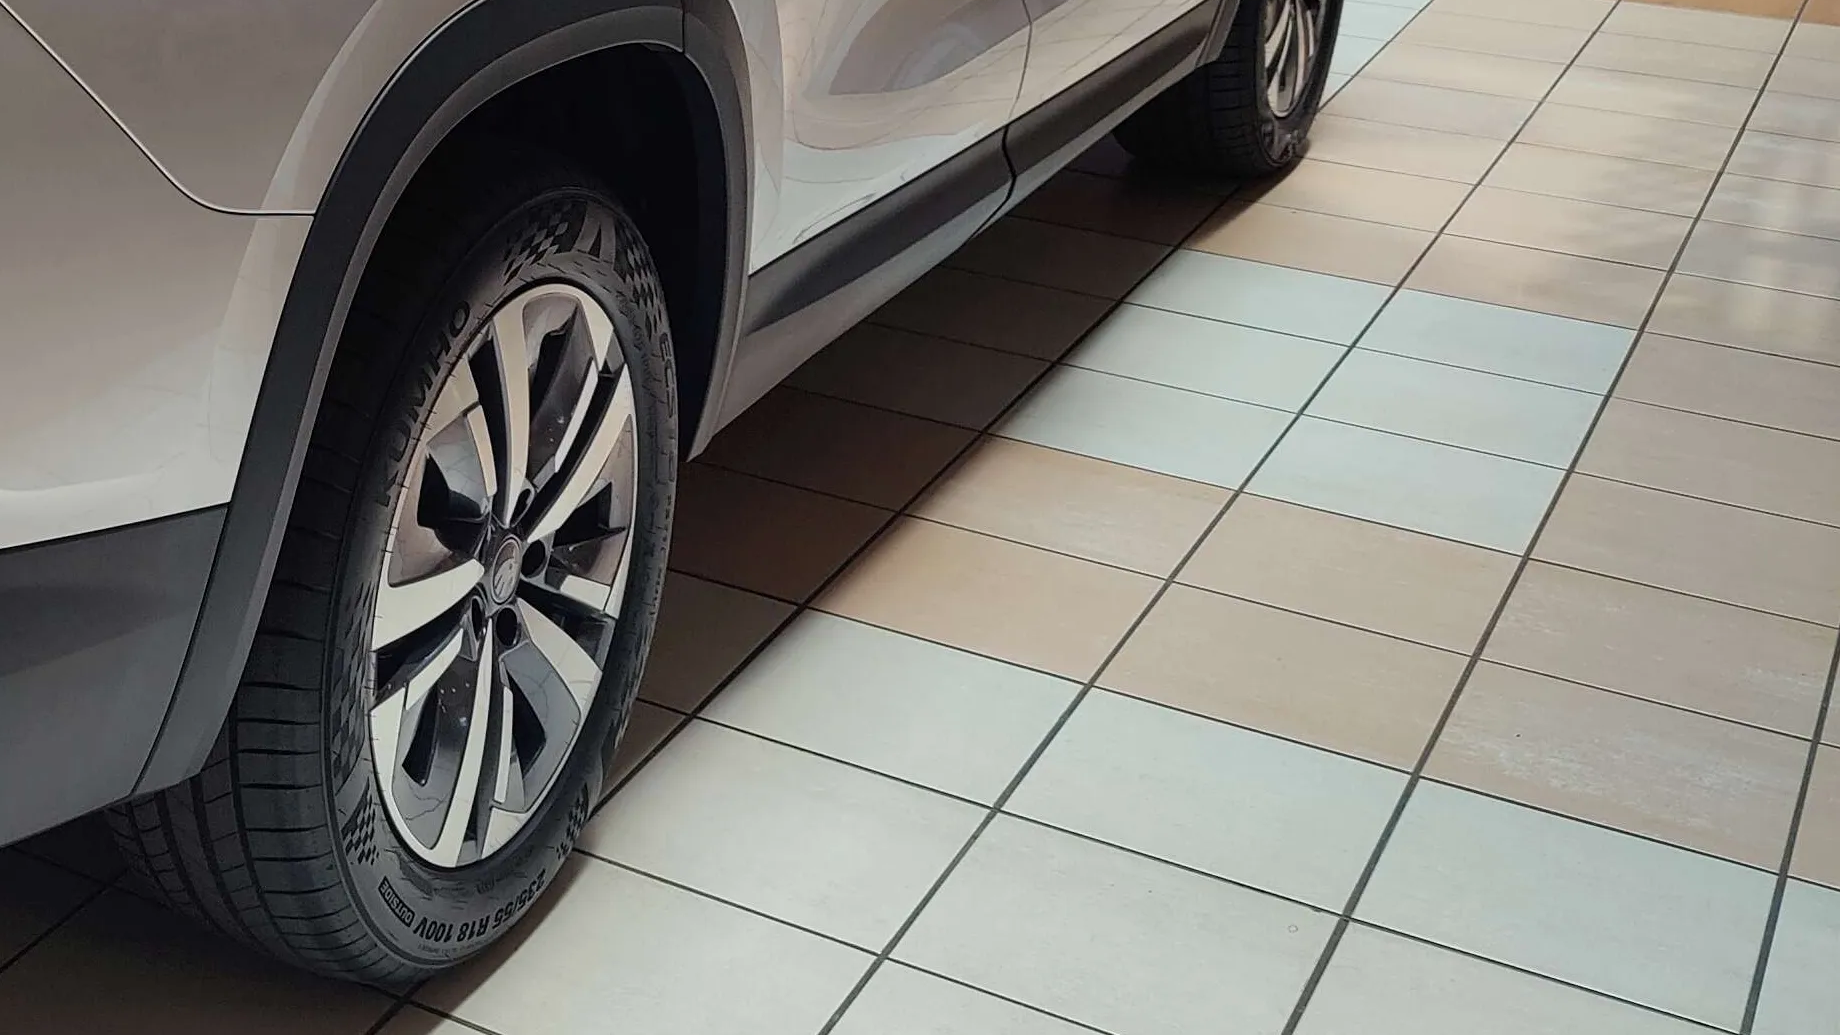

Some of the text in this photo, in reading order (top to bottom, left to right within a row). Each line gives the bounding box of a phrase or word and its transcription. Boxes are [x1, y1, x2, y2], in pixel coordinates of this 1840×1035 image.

[379, 879, 414, 925] OUTSIDE
[492, 868, 547, 930] 235/55
[412, 916, 455, 943] 100V
[456, 917, 490, 944] R18
